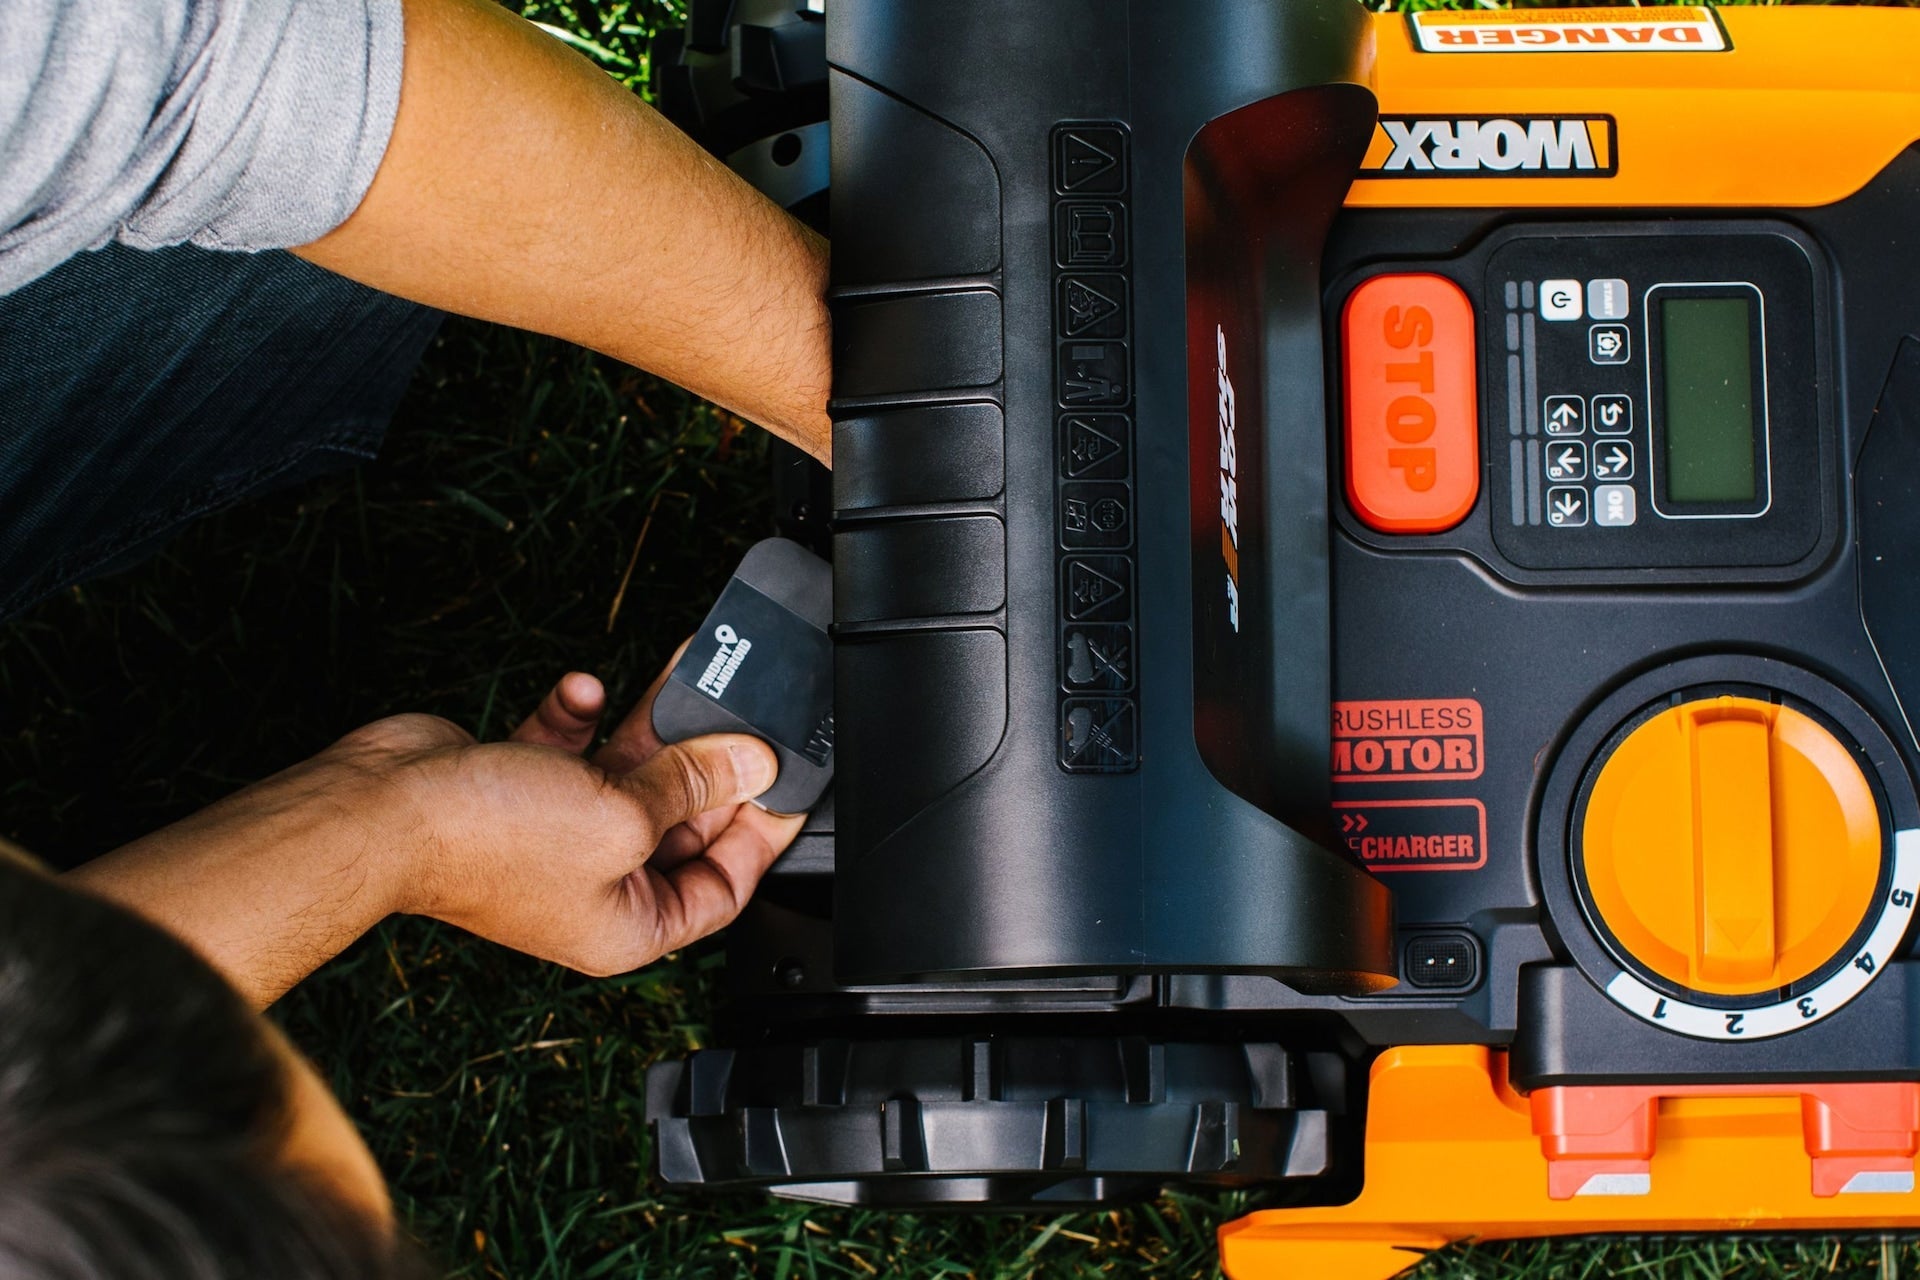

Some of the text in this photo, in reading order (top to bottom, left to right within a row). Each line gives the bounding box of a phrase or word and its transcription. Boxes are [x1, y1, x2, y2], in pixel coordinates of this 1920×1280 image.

[1437, 26, 1704, 46] DANGER
[1382, 119, 1597, 171] WORX
[1603, 281, 1613, 316] START
[1383, 305, 1437, 493] STOP
[1548, 421, 1561, 433] C
[1550, 466, 1563, 478] B
[1597, 464, 1610, 477] A
[1607, 490, 1624, 521] OK
[1551, 512, 1564, 524] D
[708, 638, 752, 700] LANDROID
[1890, 888, 1914, 909] 5
[1853, 951, 1876, 976] 4
[1652, 997, 1667, 1019] 1
[1796, 996, 1818, 1018] 3
[1725, 1013, 1744, 1035] 2
